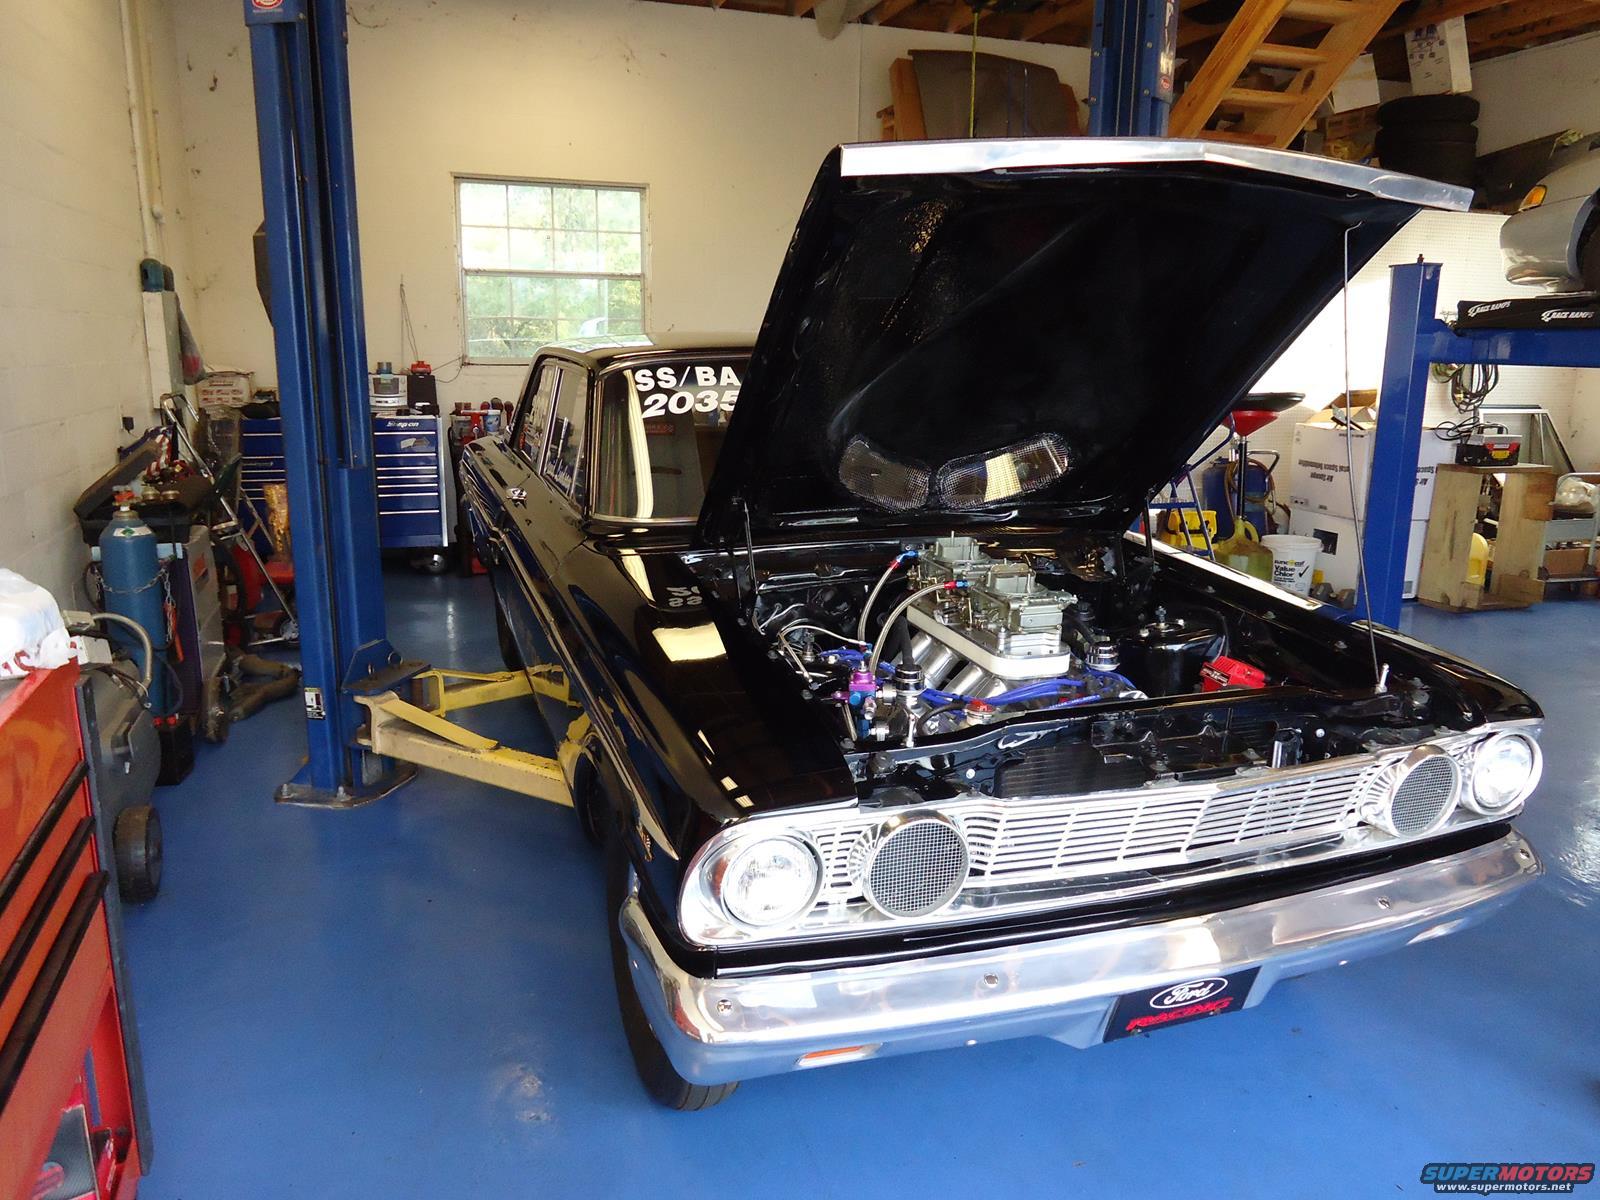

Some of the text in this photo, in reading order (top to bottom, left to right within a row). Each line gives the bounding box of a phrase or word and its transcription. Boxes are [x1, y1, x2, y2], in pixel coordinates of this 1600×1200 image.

[634, 366, 742, 392] SS/BA
[642, 390, 740, 418] 2035
[1274, 564, 1296, 572] Value
[1163, 982, 1215, 1005] Ford
